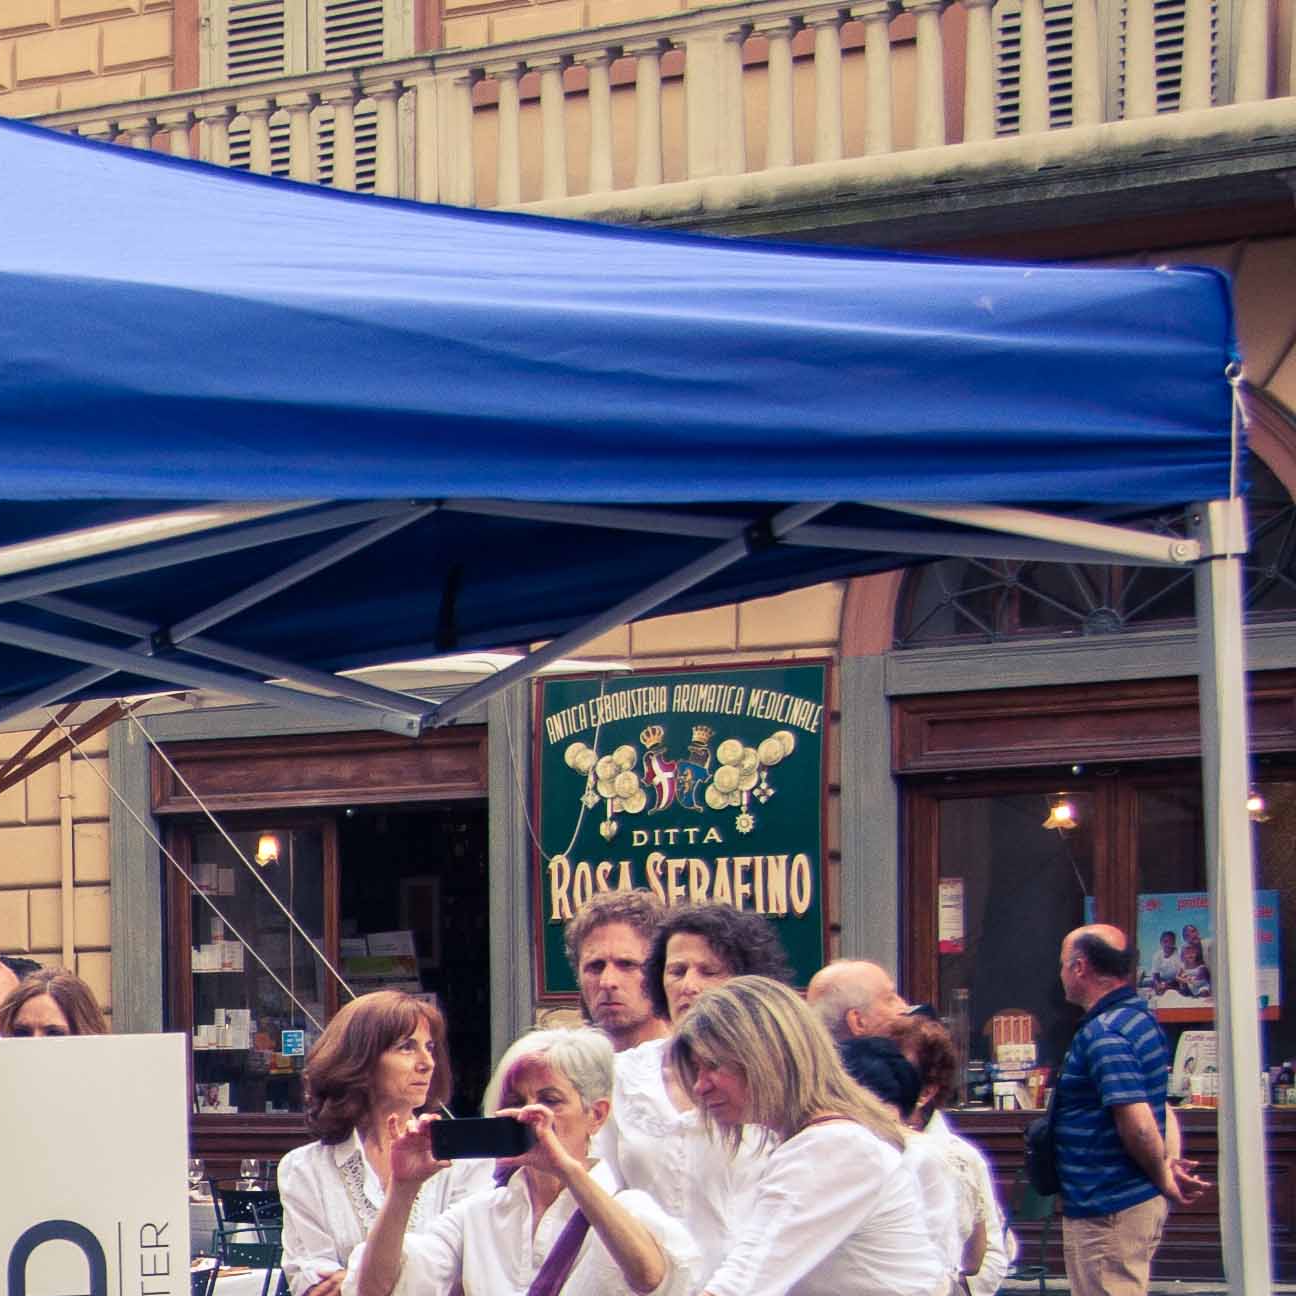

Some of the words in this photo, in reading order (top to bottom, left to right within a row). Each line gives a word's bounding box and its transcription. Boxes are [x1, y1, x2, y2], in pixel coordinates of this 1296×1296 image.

[545, 705, 588, 745] ANTICA
[590, 685, 667, 727] ERBORISTERIA
[672, 683, 744, 716] AROMATICA
[746, 689, 824, 733] MEDICINALE
[632, 827, 723, 846] DITTA
